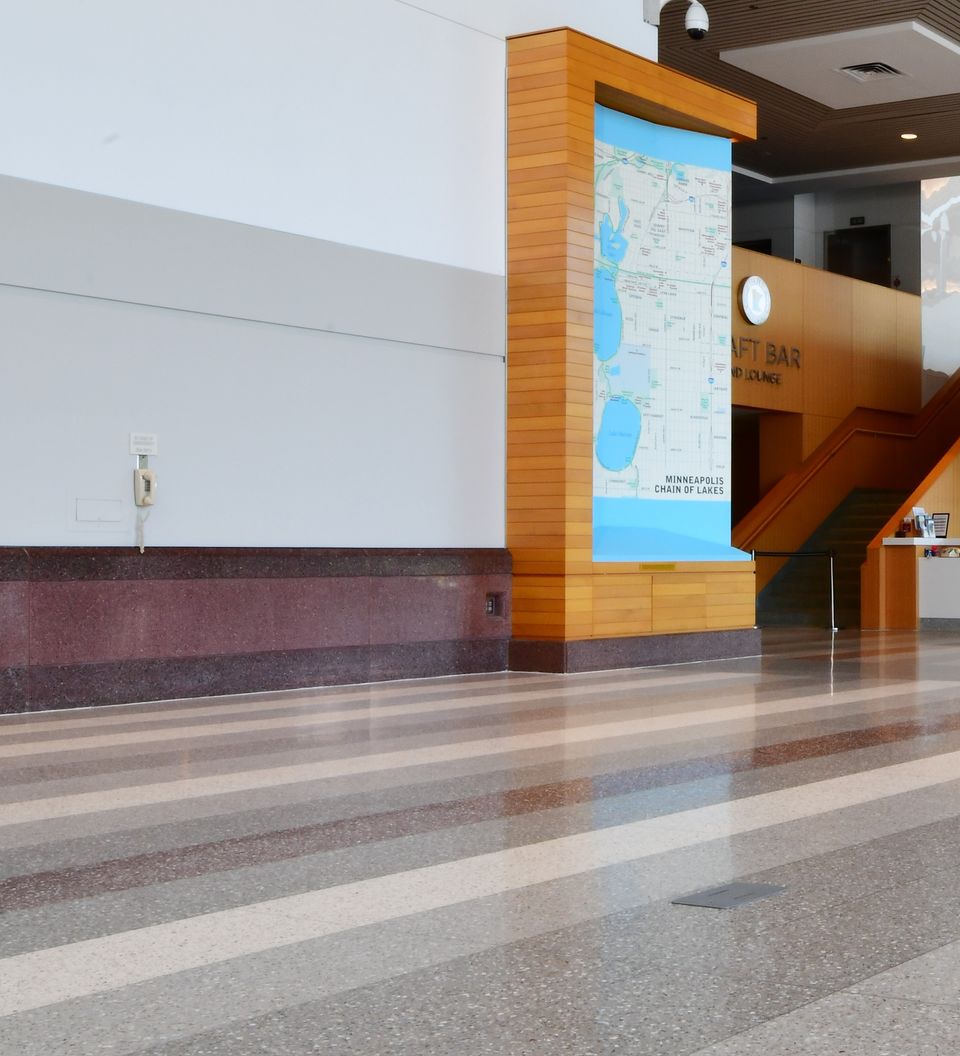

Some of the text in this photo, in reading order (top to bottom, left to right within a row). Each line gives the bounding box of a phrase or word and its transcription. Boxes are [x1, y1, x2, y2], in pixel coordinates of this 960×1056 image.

[766, 342, 801, 369] BAR
[745, 368, 783, 385] LOUNGE
[665, 475, 724, 486] MINNEAPOLIS
[654, 484, 724, 495] CHAIN OF LAKES
